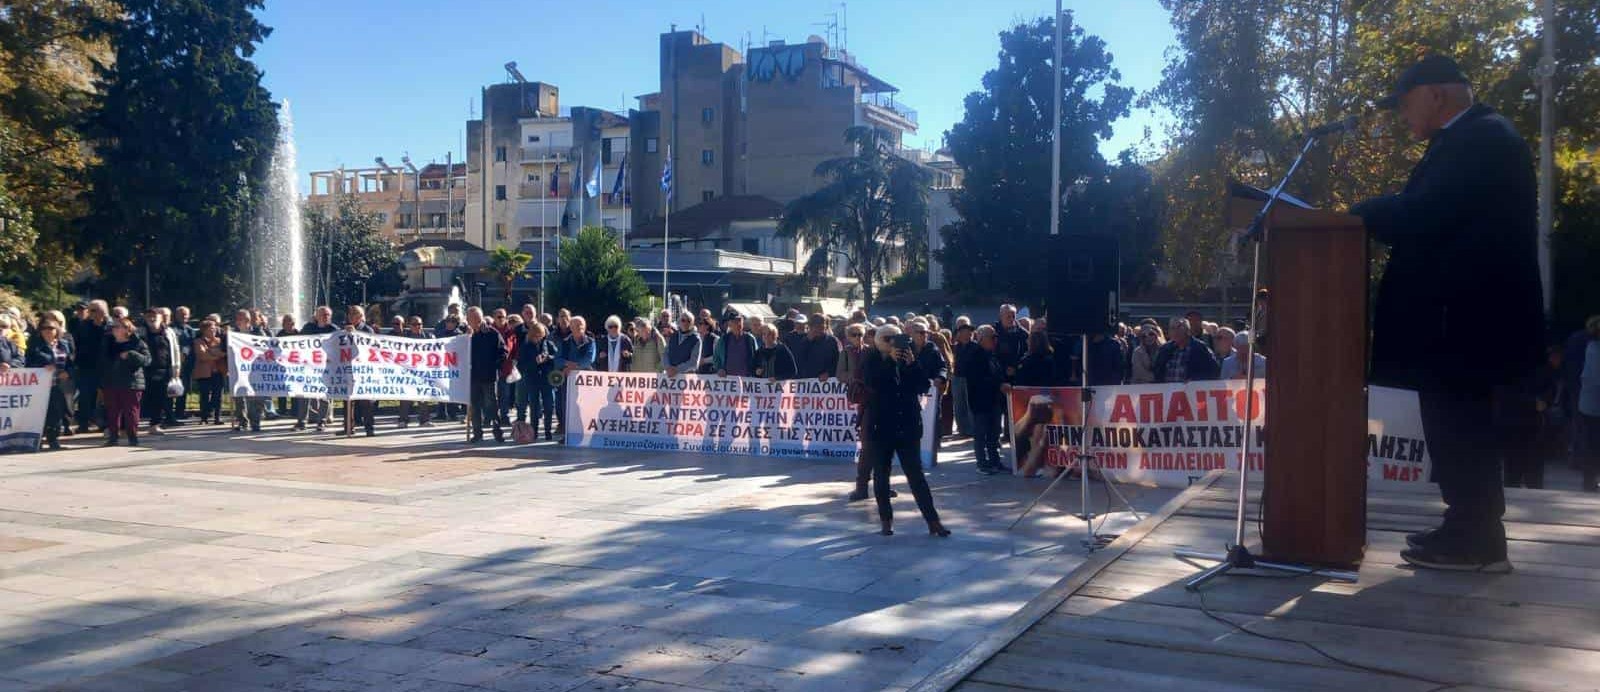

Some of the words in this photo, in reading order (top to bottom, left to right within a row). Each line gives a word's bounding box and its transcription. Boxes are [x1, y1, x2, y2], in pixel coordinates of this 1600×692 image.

[575, 375, 603, 387] ΔΕΝ
[607, 376, 738, 392] ΣΥΜΒΙΒΑΖΟΜΑΣΤΕ
[743, 382, 761, 393] ΜΕ
[765, 383, 784, 393] ΤΑ
[614, 391, 644, 404] ΔΕΝ
[650, 393, 749, 408] ΑΝΤΕΧΟΥΜΕ
[755, 397, 775, 409] ΤΙΣ
[622, 406, 653, 419] ΔΕΝ
[658, 408, 752, 423] ΑΝΤΕΧΟΥΜΕ
[758, 412, 788, 424] ΤΗΝ
[793, 412, 857, 426] ΑΚΡΙΒΕΙΑ
[588, 419, 660, 434] ΑΥΞΗΣΕΙΣ
[665, 421, 704, 436] ΤΩΡΑ
[709, 425, 726, 437] ΣΕ
[731, 426, 772, 439] ΟΛΕΣ
[776, 428, 800, 440] ΤΙΣ
[804, 428, 860, 442] ΣΥΝΤΑ
[1047, 425, 1083, 446] ΤΗΝ
